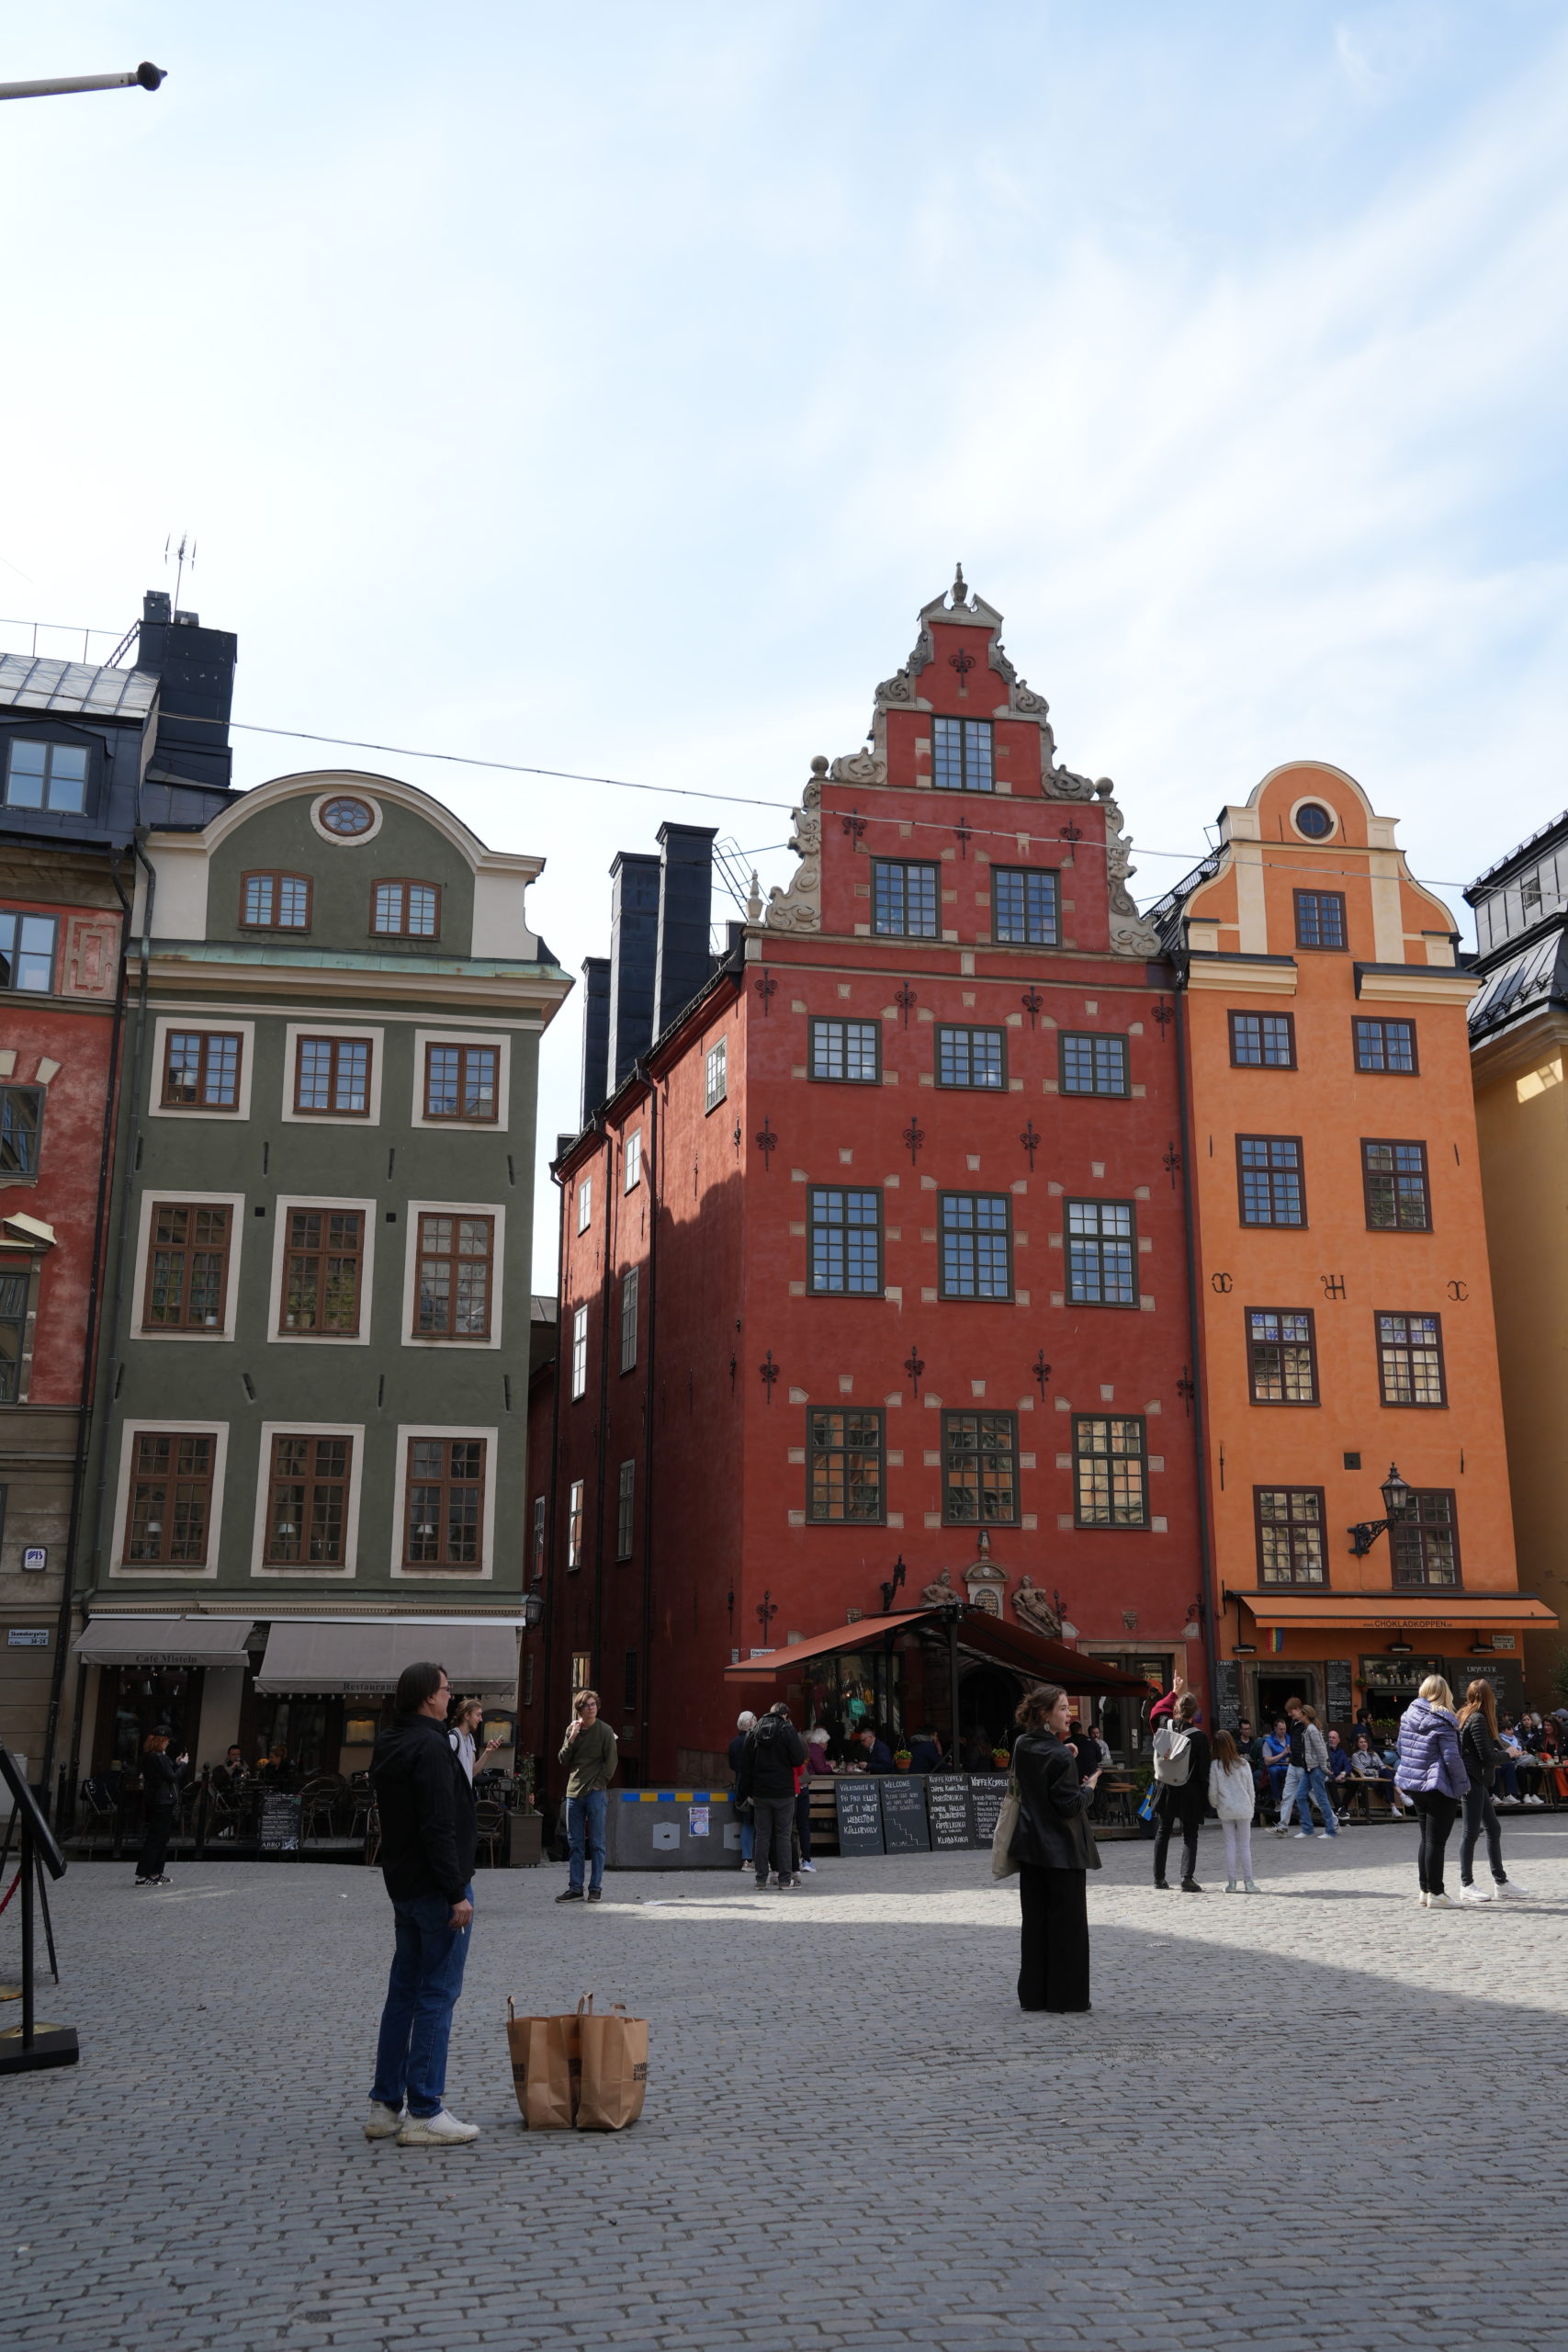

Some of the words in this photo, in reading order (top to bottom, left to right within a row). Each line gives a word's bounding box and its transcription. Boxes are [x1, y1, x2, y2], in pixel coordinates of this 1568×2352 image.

[136, 1654, 159, 1663] Café
[161, 1654, 197, 1664] Misteln
[884, 1780, 911, 1789] WELCOME
